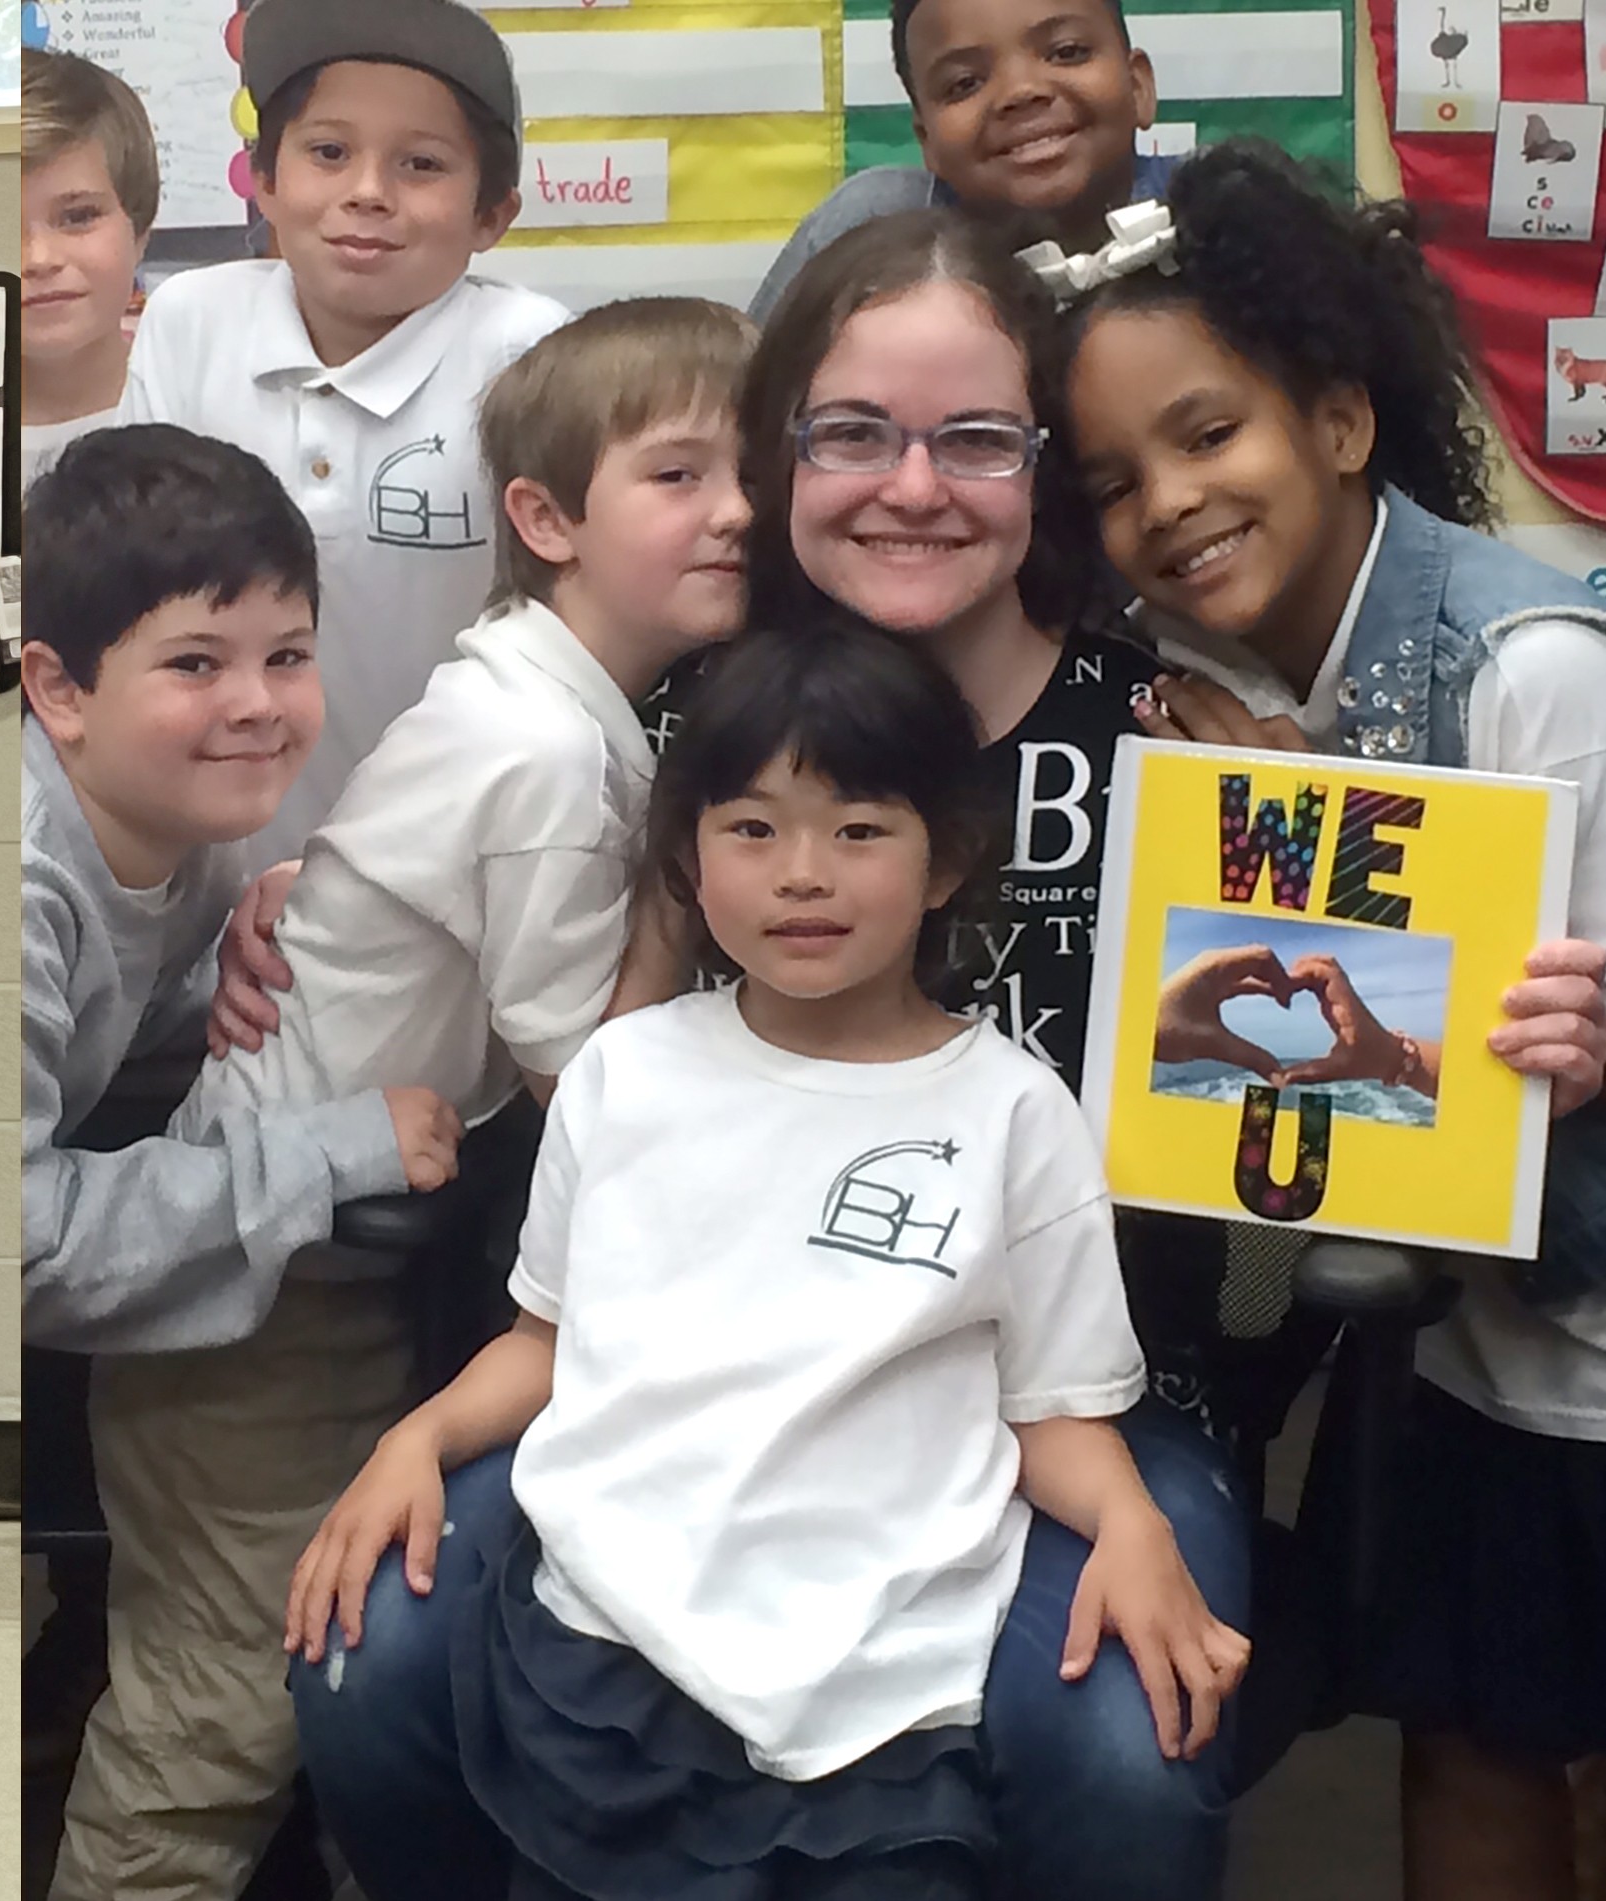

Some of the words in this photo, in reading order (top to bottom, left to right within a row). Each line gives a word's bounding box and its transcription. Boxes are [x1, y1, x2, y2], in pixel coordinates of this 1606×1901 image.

[82, 26, 156, 41] Wonderful
[535, 156, 633, 204] trade
[1218, 773, 1427, 930] WE
[999, 881, 1098, 905] Square
[1233, 1083, 1333, 1223] U
[824, 1174, 961, 1259] BH
